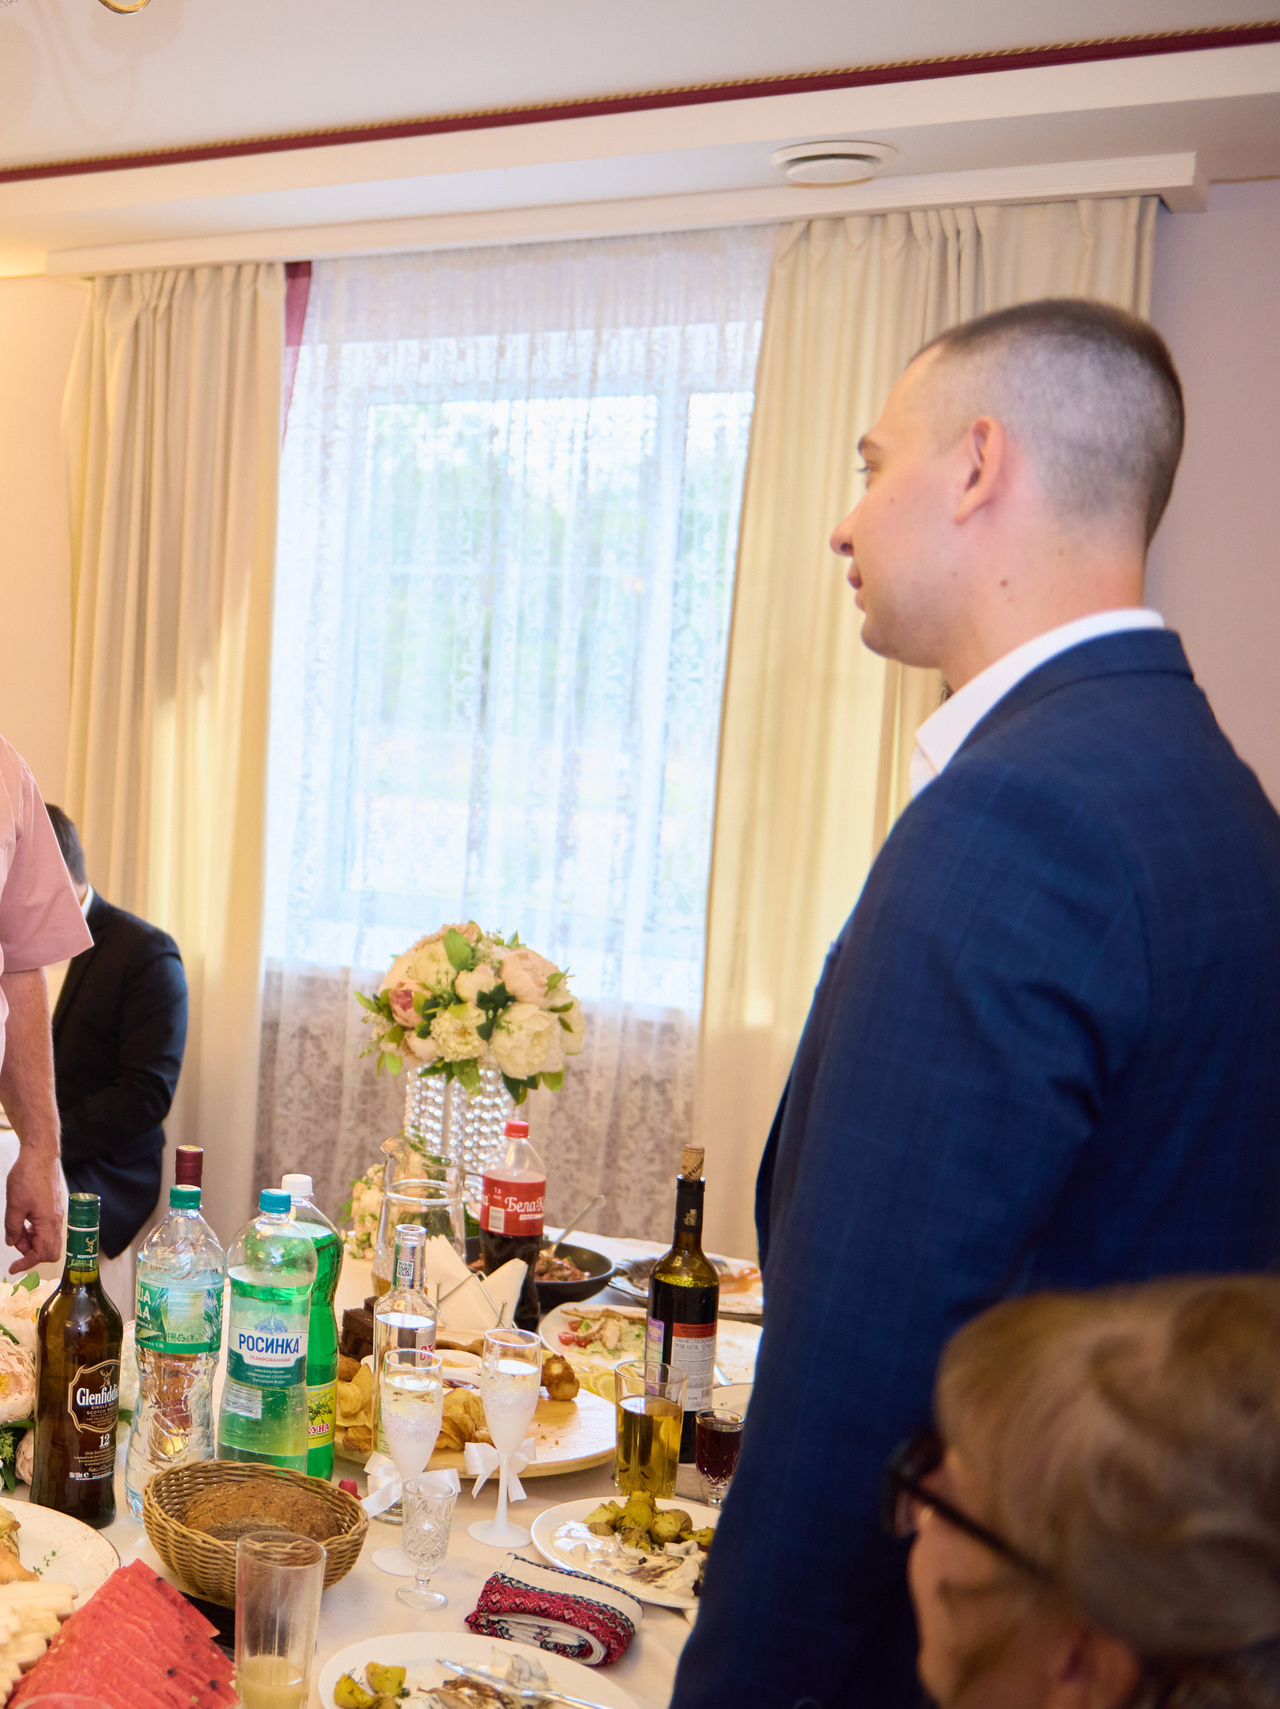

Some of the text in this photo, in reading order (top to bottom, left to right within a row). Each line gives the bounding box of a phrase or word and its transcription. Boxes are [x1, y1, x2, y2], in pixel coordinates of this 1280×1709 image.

[504, 1196, 546, 1213] Бела-К
[238, 1333, 299, 1354] РОСИНКА
[249, 1354, 291, 1363] ГАЗИРОВАННАЯ
[76, 1383, 119, 1406] Glenfiddi
[99, 1433, 110, 1448] 12
